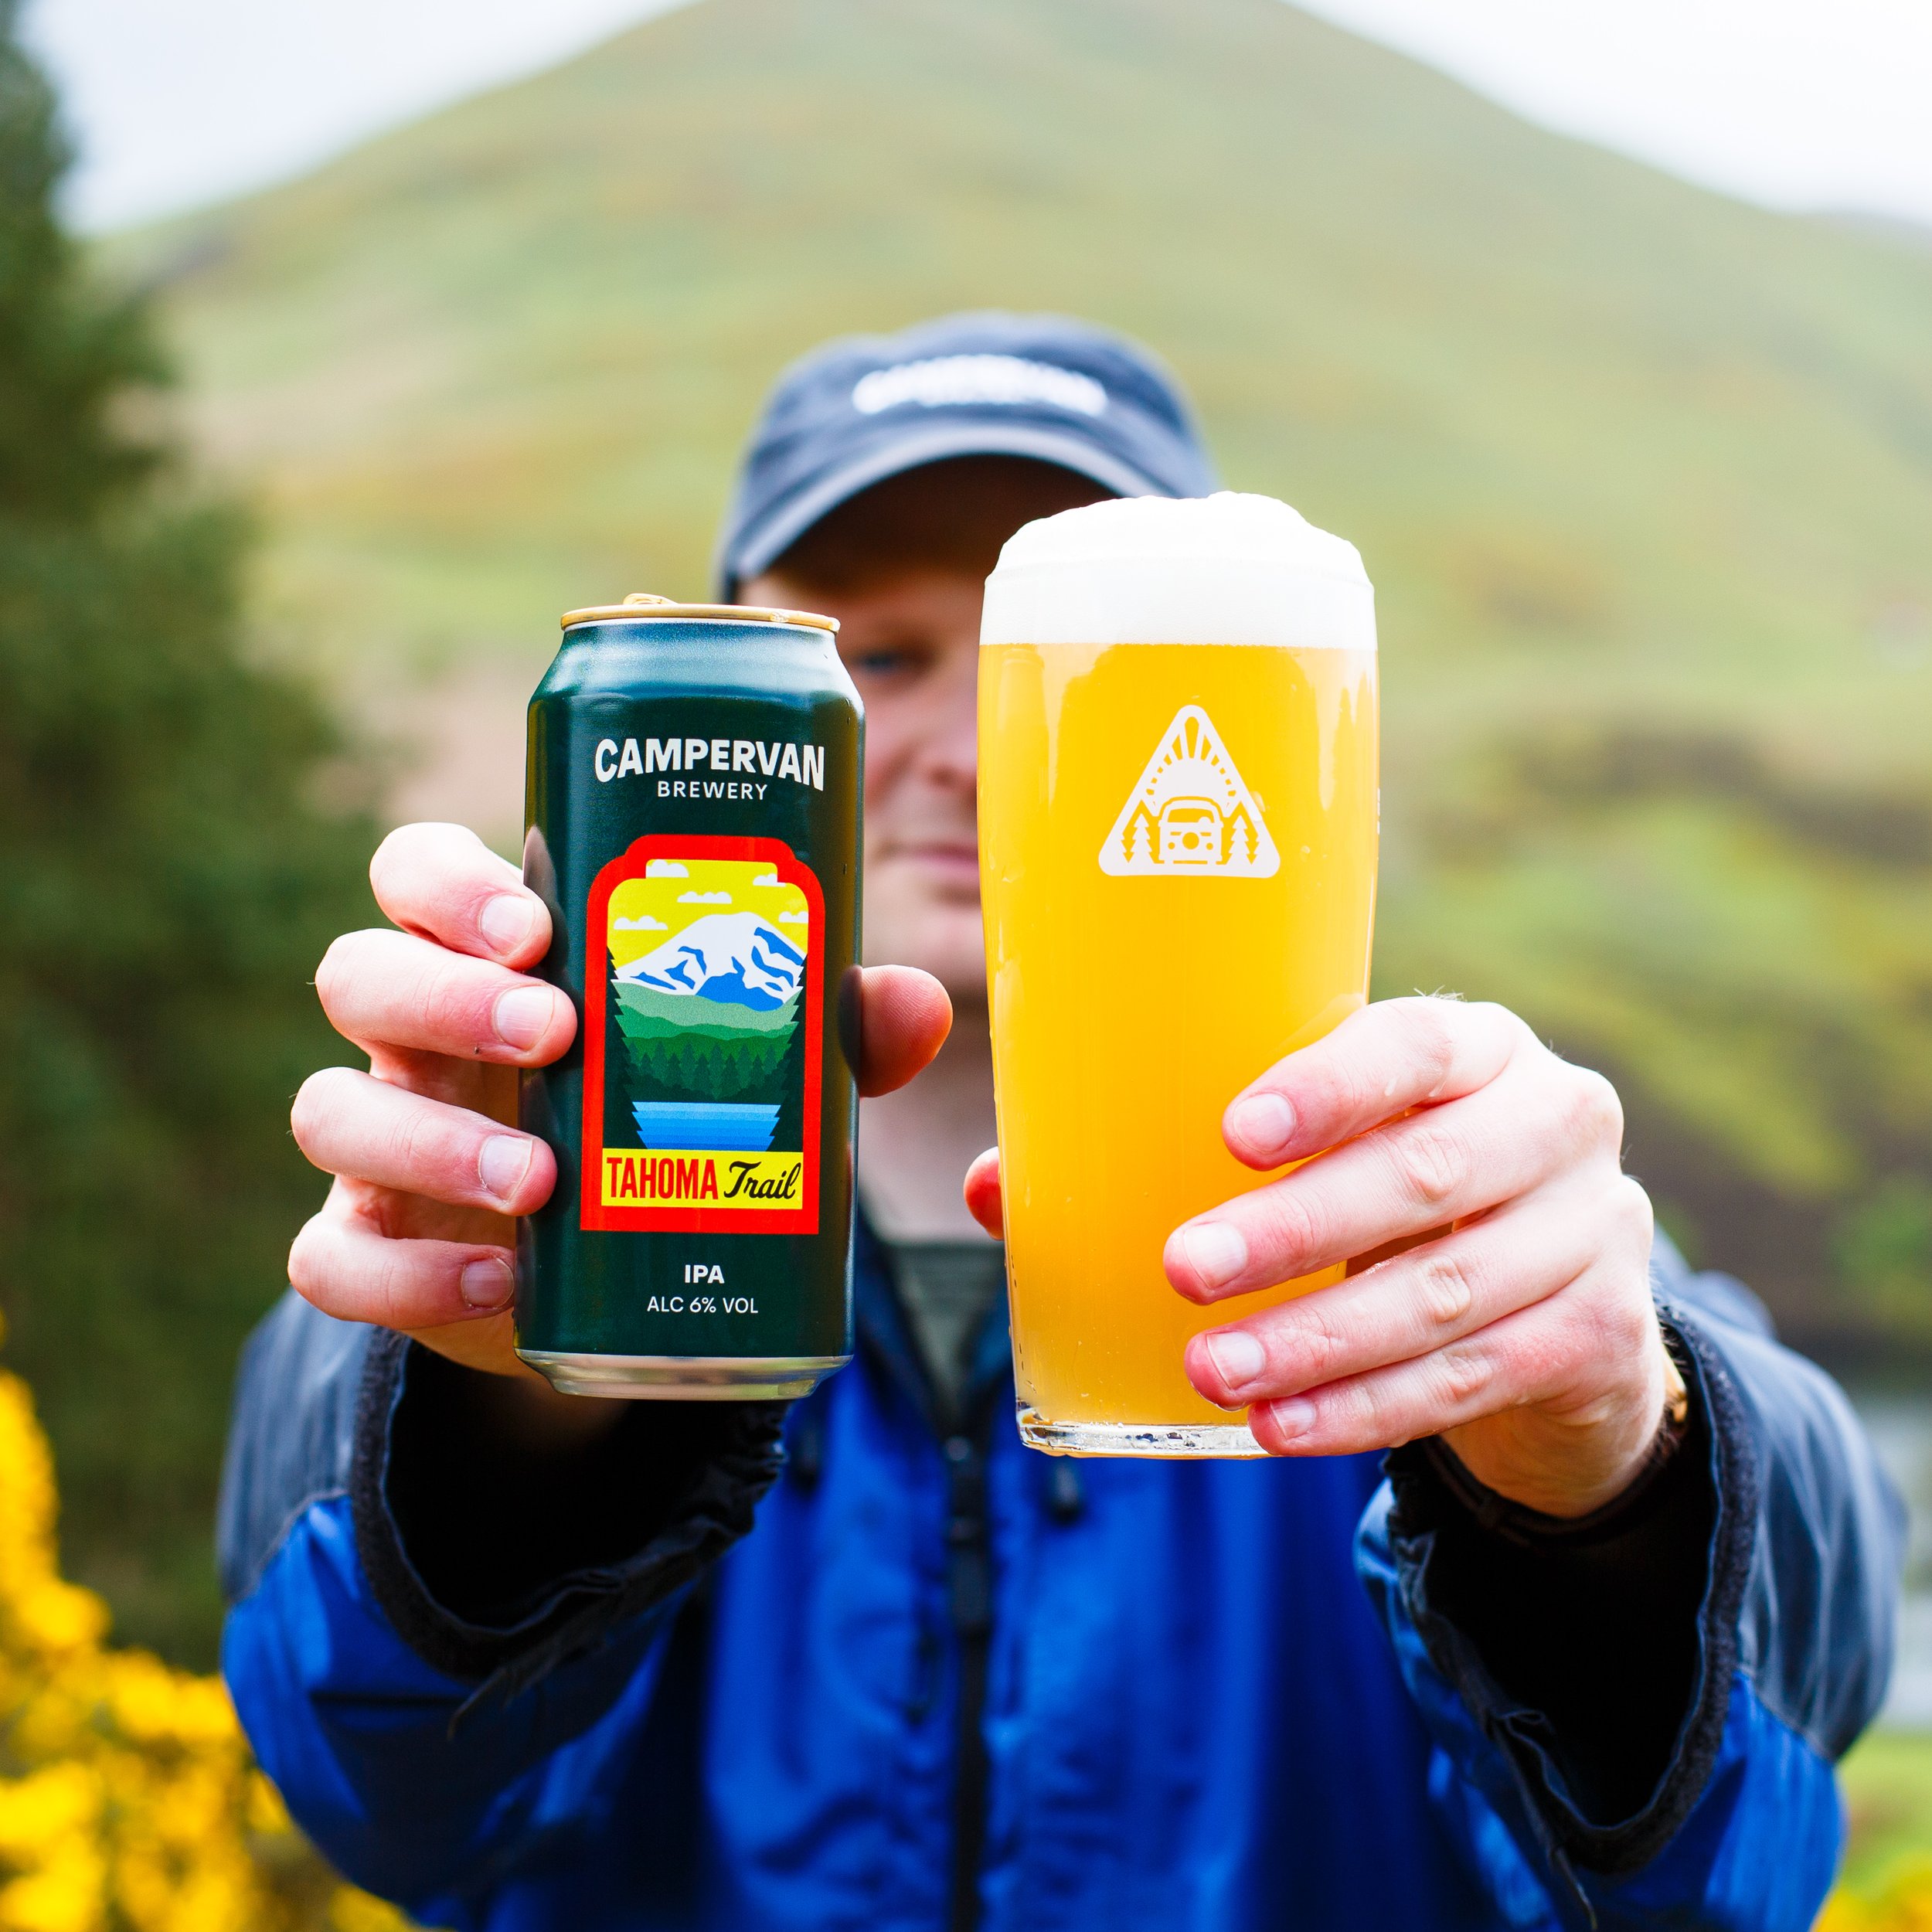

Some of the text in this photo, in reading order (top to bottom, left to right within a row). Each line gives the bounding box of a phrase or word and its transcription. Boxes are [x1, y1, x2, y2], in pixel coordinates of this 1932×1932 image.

[594, 738, 825, 791] CAMPERVAN
[657, 781, 768, 801] BREWERY
[607, 1157, 802, 1199] TAHOMA Trail
[684, 1264, 725, 1284] IPA
[646, 1296, 759, 1314] ALC 6% VOL
